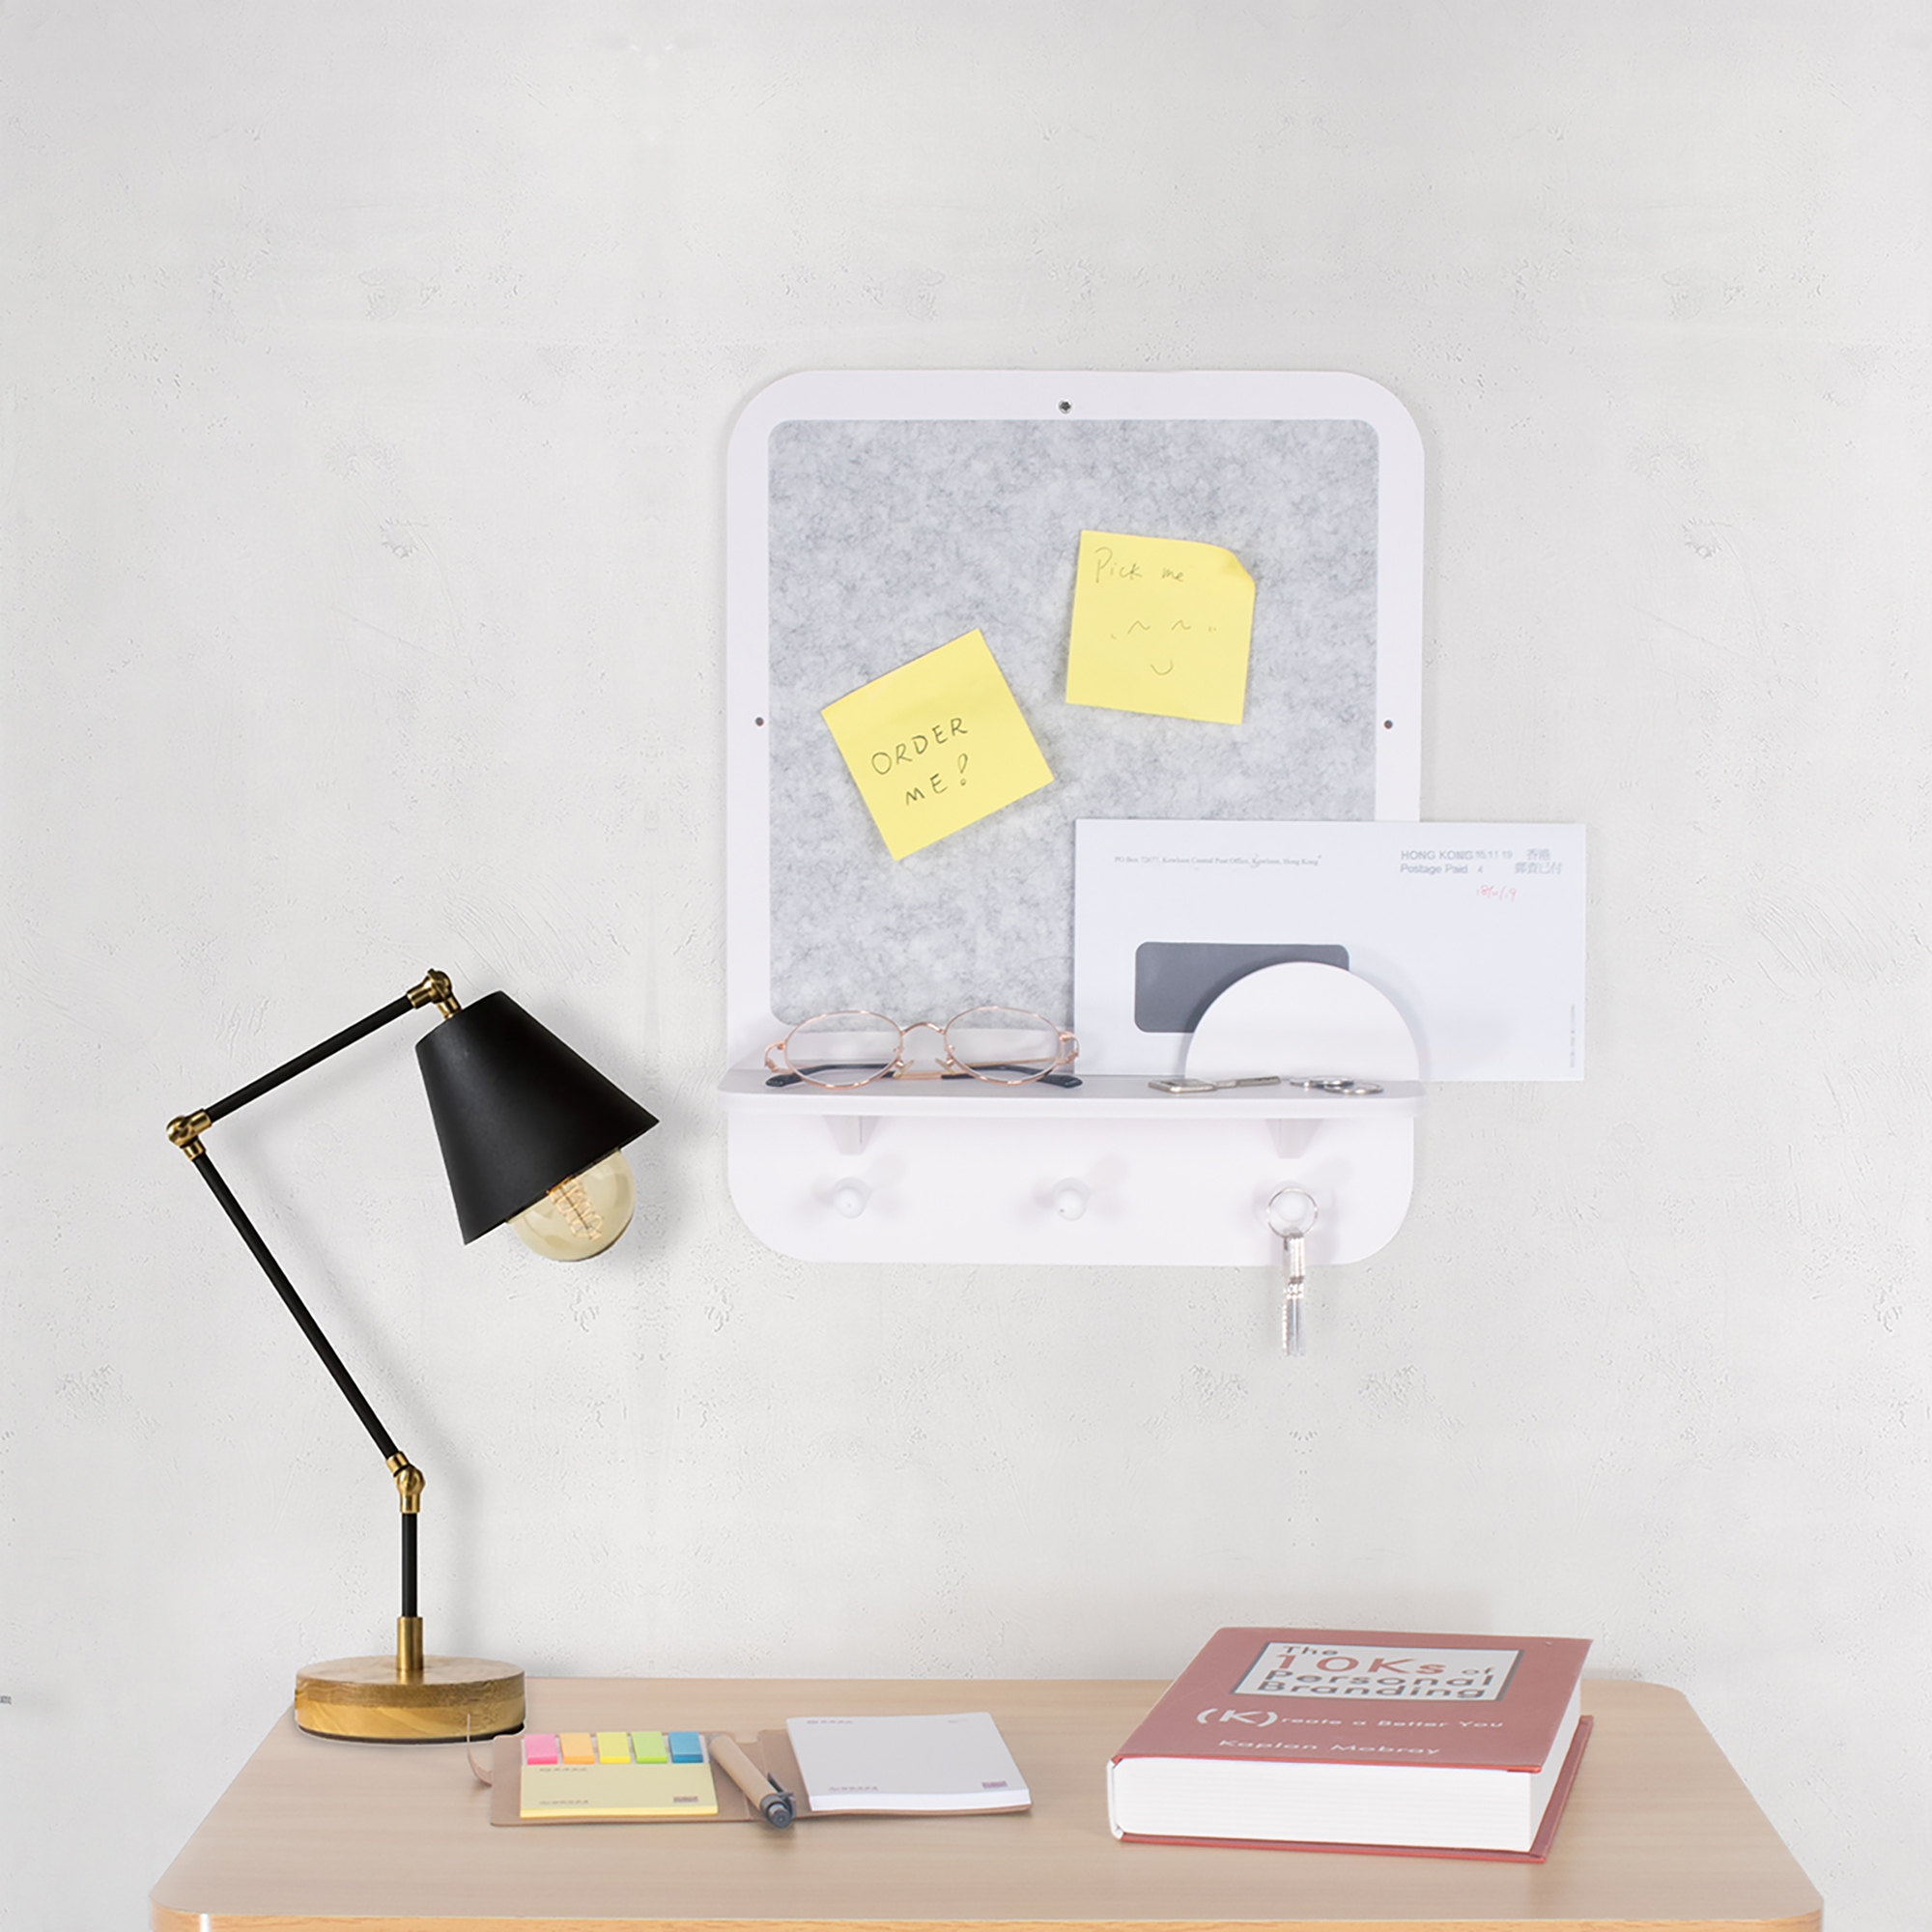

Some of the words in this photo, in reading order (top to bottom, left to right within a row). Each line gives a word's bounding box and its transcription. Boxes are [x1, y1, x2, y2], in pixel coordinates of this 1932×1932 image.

[1095, 547, 1143, 582] Pick
[1161, 568, 1184, 582] me
[871, 717, 968, 775] ORDER
[905, 753, 969, 806] ME!
[1191, 856, 1213, 865] Central
[1301, 858, 1319, 867] Kong
[1401, 850, 1435, 860] HONG
[1439, 850, 1473, 860] KONG
[1401, 863, 1442, 875] Postage
[1445, 863, 1468, 873] Paid
[1283, 1645, 1339, 1656] The
[1276, 1654, 1446, 1675] 10Ks
[1462, 1666, 1494, 1675] of
[1264, 1669, 1494, 1687] Personal
[1256, 1680, 1486, 1699] Branding
[1378, 1719, 1449, 1728] Better
[1218, 1739, 1318, 1750] Kaplan
[1330, 1744, 1441, 1755] Mobray
